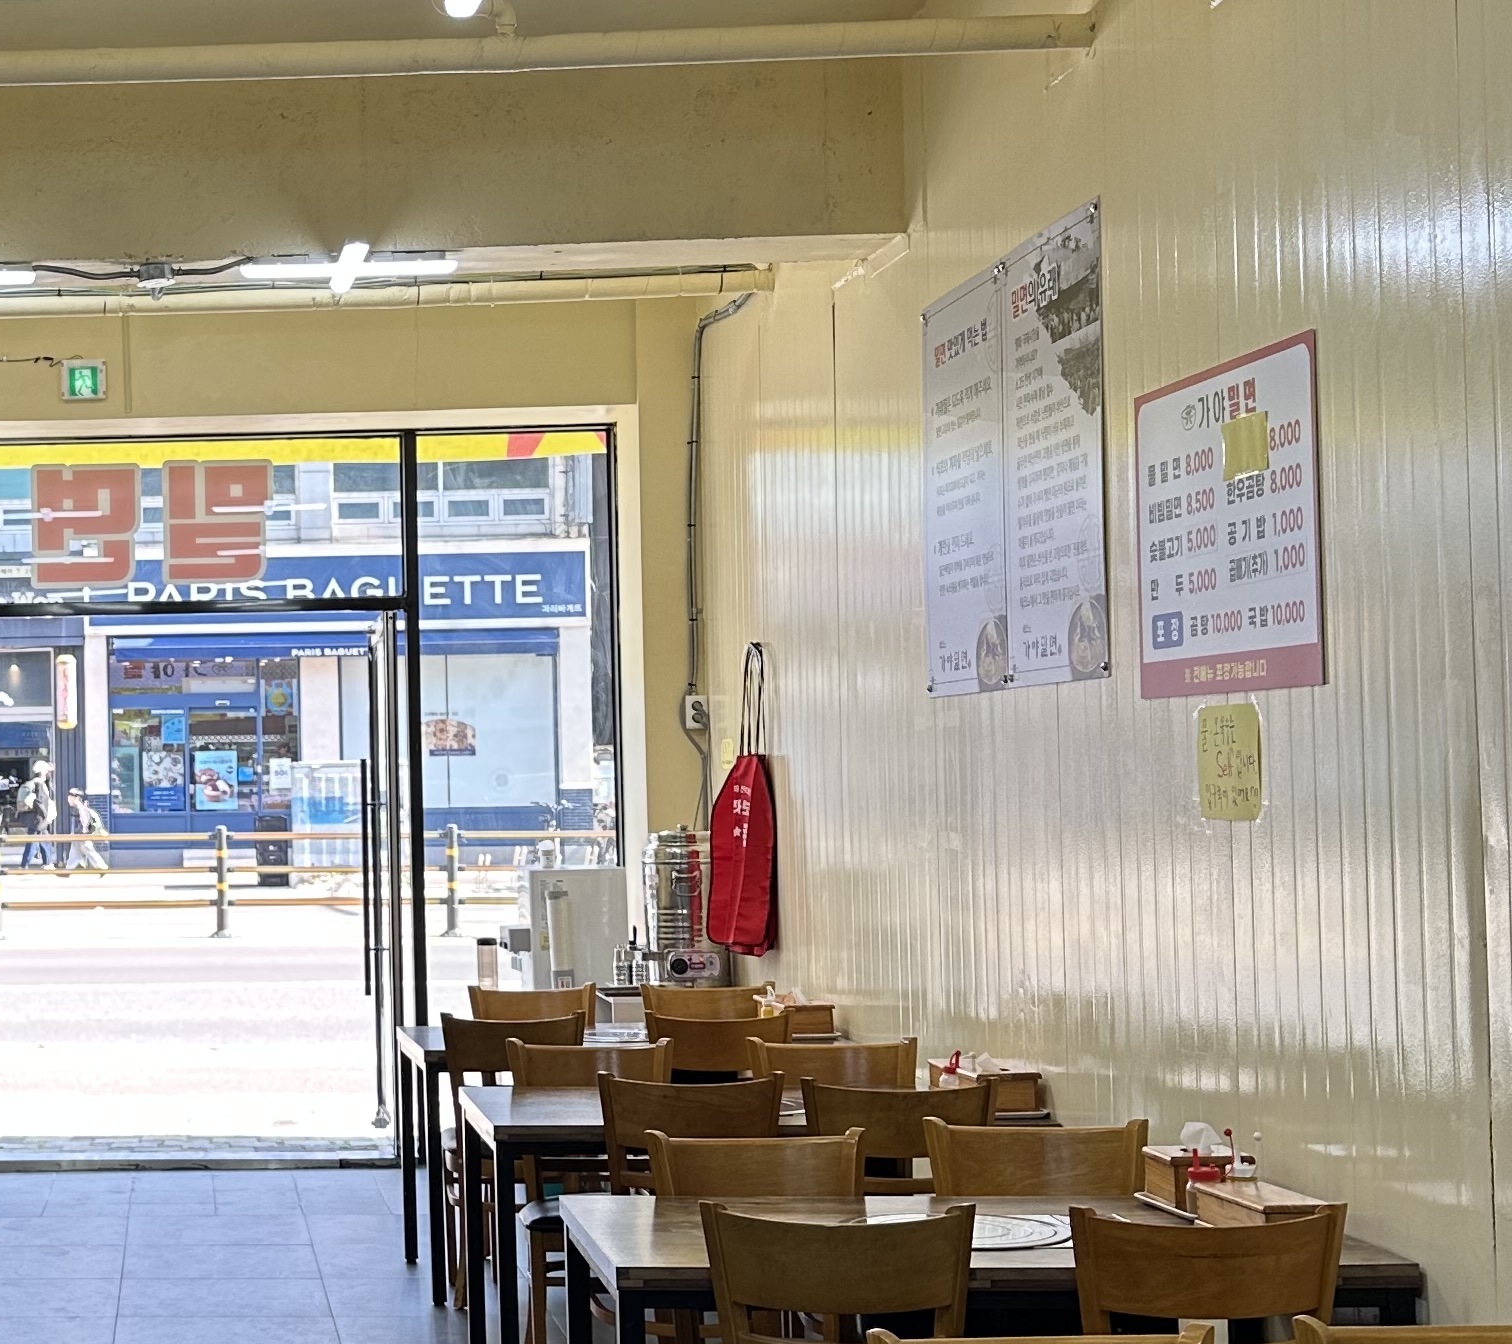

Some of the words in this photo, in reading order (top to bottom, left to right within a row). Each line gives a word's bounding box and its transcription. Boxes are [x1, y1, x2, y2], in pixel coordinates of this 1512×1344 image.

[1011, 276, 1038, 319] 밀면의
[1037, 264, 1059, 306] 유래
[934, 341, 946, 368] 밀면
[947, 330, 966, 361] 맛있게
[967, 324, 979, 348] 먹는
[1198, 376, 1259, 429] 가야밀면
[1184, 444, 1214, 477] 8,000
[1267, 417, 1301, 453] 8,000
[1185, 485, 1215, 517] 8,500
[1225, 471, 1265, 506] 한우곰탕
[1269, 461, 1302, 495] 8,000
[1186, 523, 1216, 555] 5,000
[1271, 505, 1303, 537] 1,000
[286, 573, 543, 605] BAGETTE
[1187, 566, 1217, 596] 5,000
[1272, 540, 1305, 574] 1,000
[1210, 607, 1243, 635] 10,000
[1270, 598, 1305, 626] 10,000
[291, 649, 322, 657] PARIS
[323, 648, 369, 656] BAGUET
